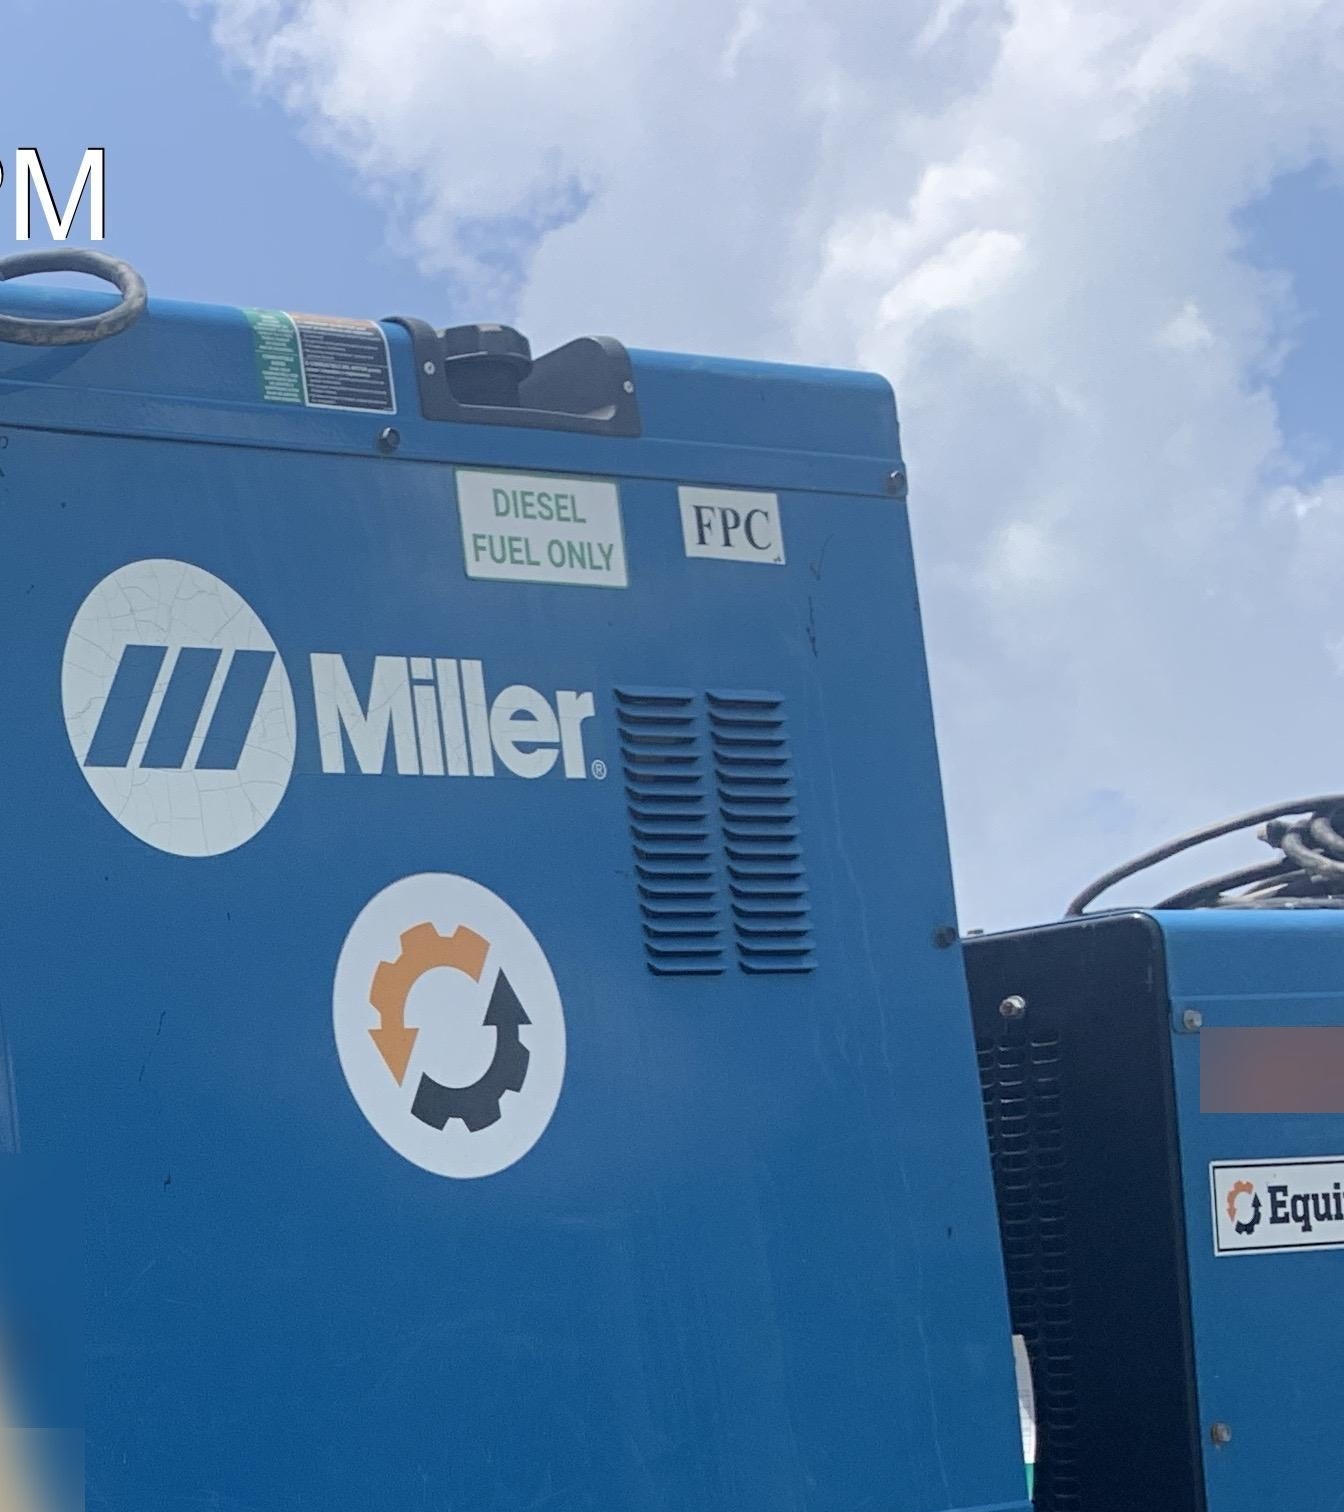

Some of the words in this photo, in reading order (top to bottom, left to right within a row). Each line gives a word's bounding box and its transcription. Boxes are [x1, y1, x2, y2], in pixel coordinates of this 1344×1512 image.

[491, 487, 587, 525] DIESEL
[692, 503, 774, 552] FPC
[471, 533, 541, 567] FUEL
[547, 539, 615, 572] ONLY
[1267, 1181, 1344, 1233] Equi
